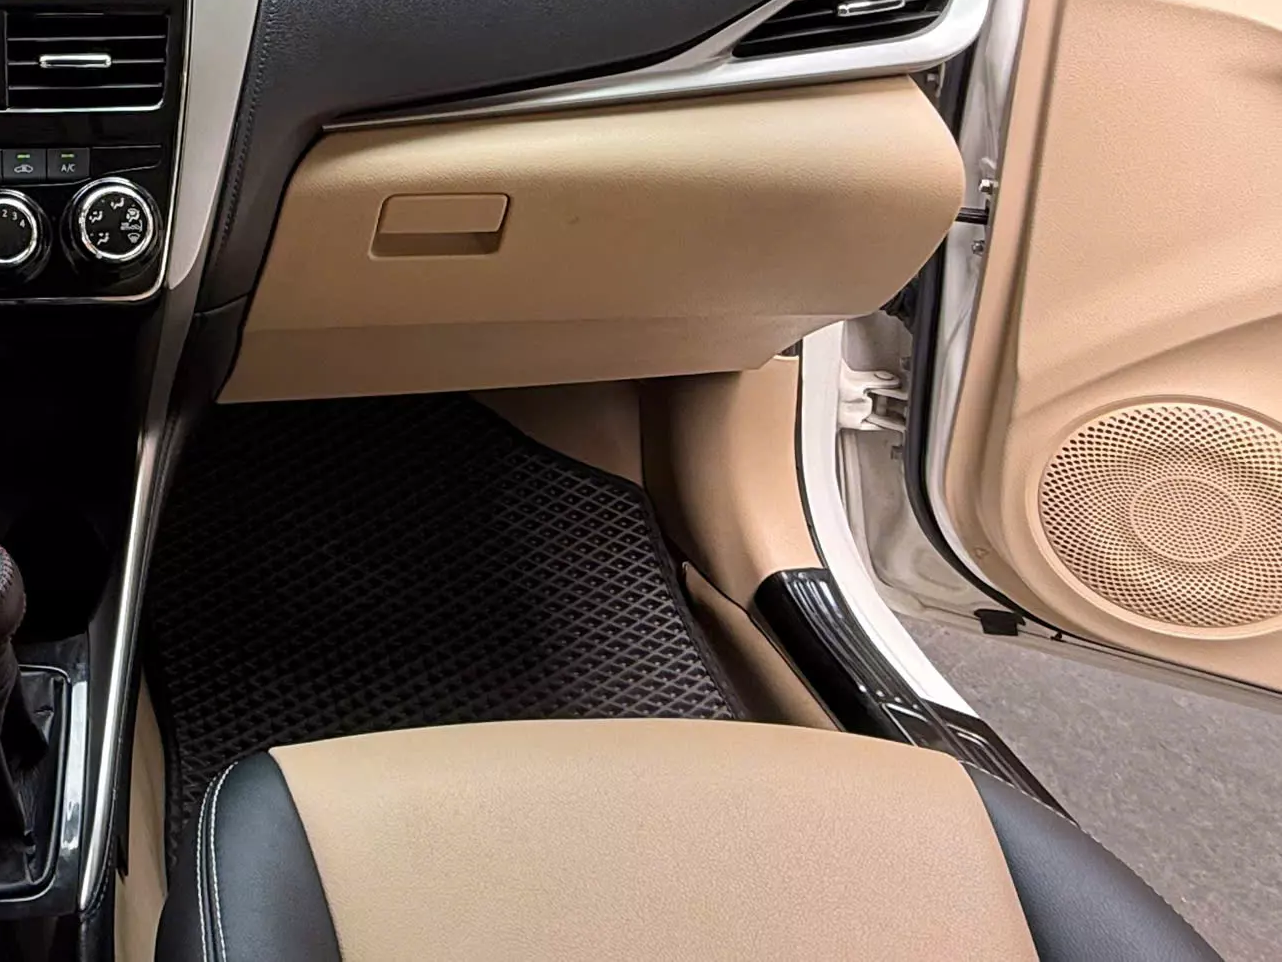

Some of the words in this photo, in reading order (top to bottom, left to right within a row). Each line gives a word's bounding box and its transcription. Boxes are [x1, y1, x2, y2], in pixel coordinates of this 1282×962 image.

[61, 164, 75, 173] A/C
[2, 209, 8, 218] 2
[12, 212, 18, 220] 3
[20, 219, 26, 228] 4
